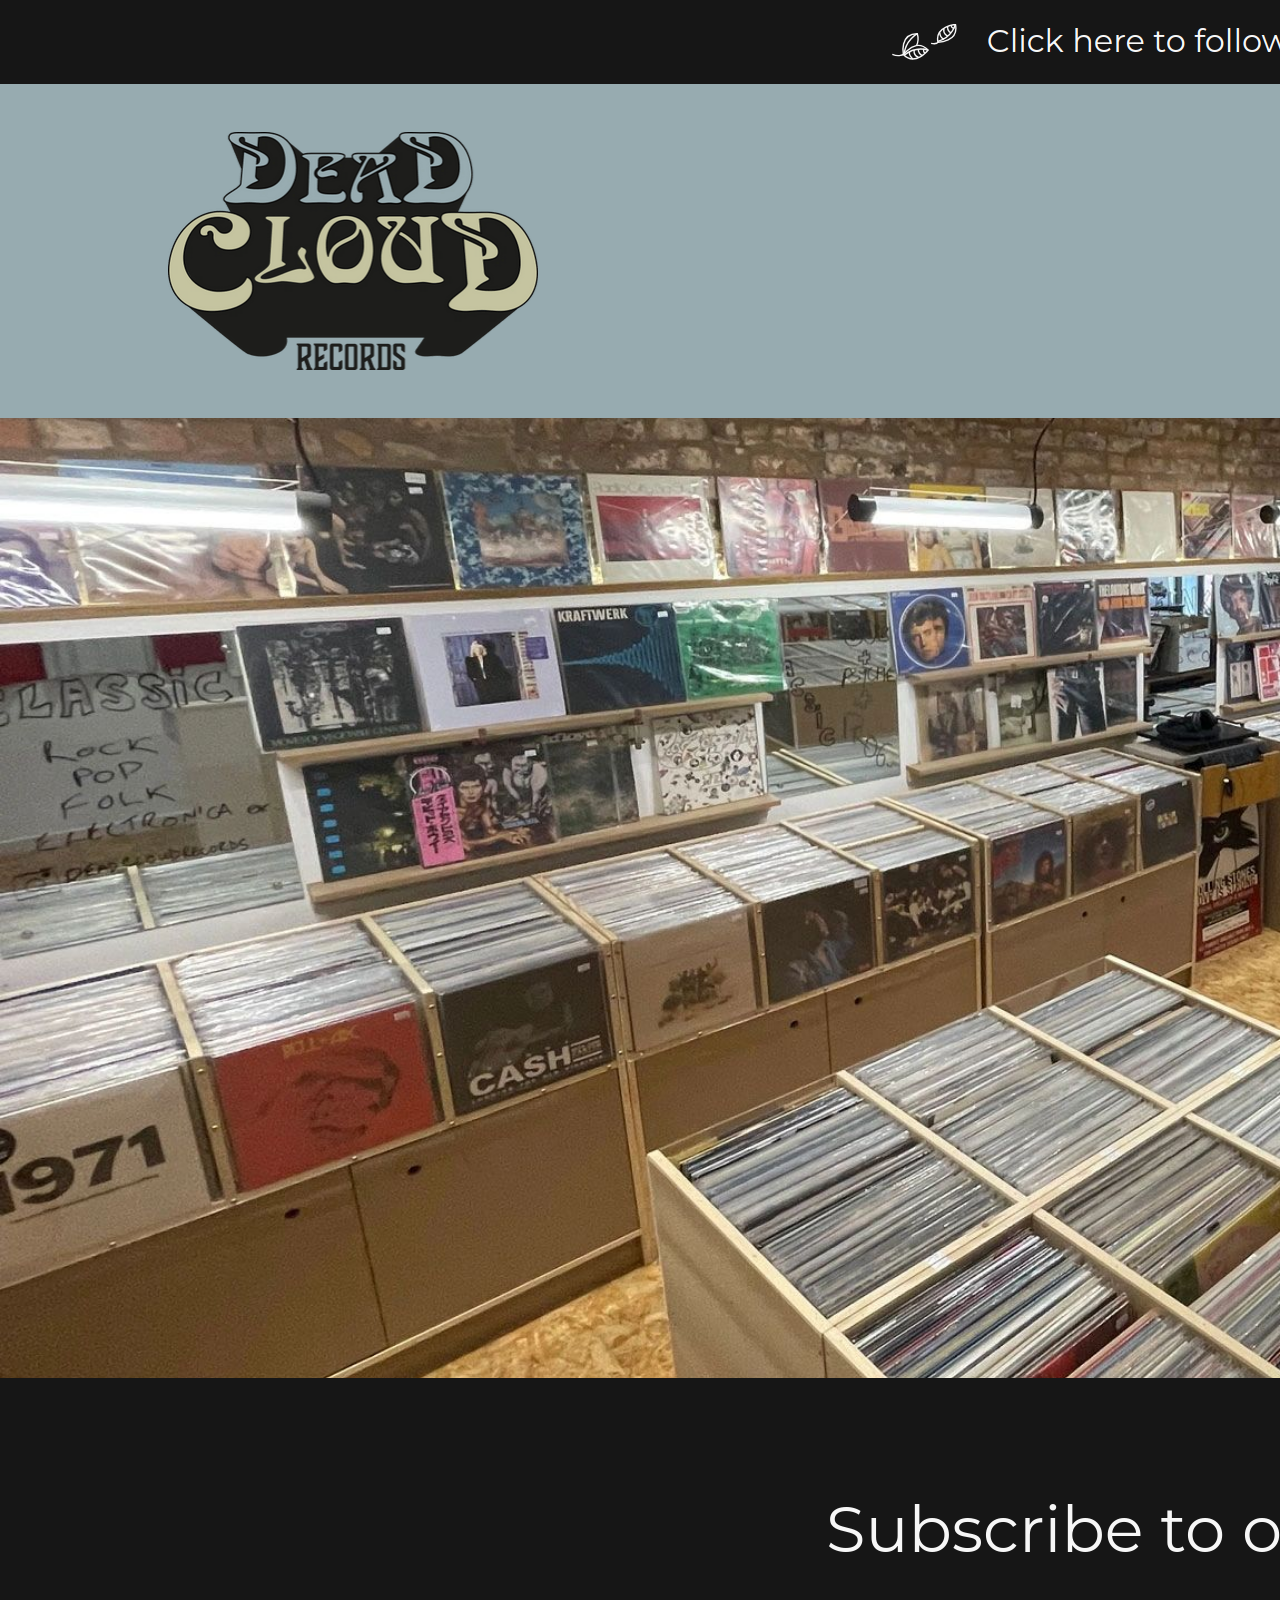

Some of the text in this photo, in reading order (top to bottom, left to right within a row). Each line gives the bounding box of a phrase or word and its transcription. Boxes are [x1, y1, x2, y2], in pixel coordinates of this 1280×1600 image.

[557, 607, 629, 624] KRAFTWERK
[72, 760, 143, 787] POP
[60, 784, 176, 819] FOLK
[469, 1045, 573, 1097] CASH
[0, 1124, 166, 1216] 1971
